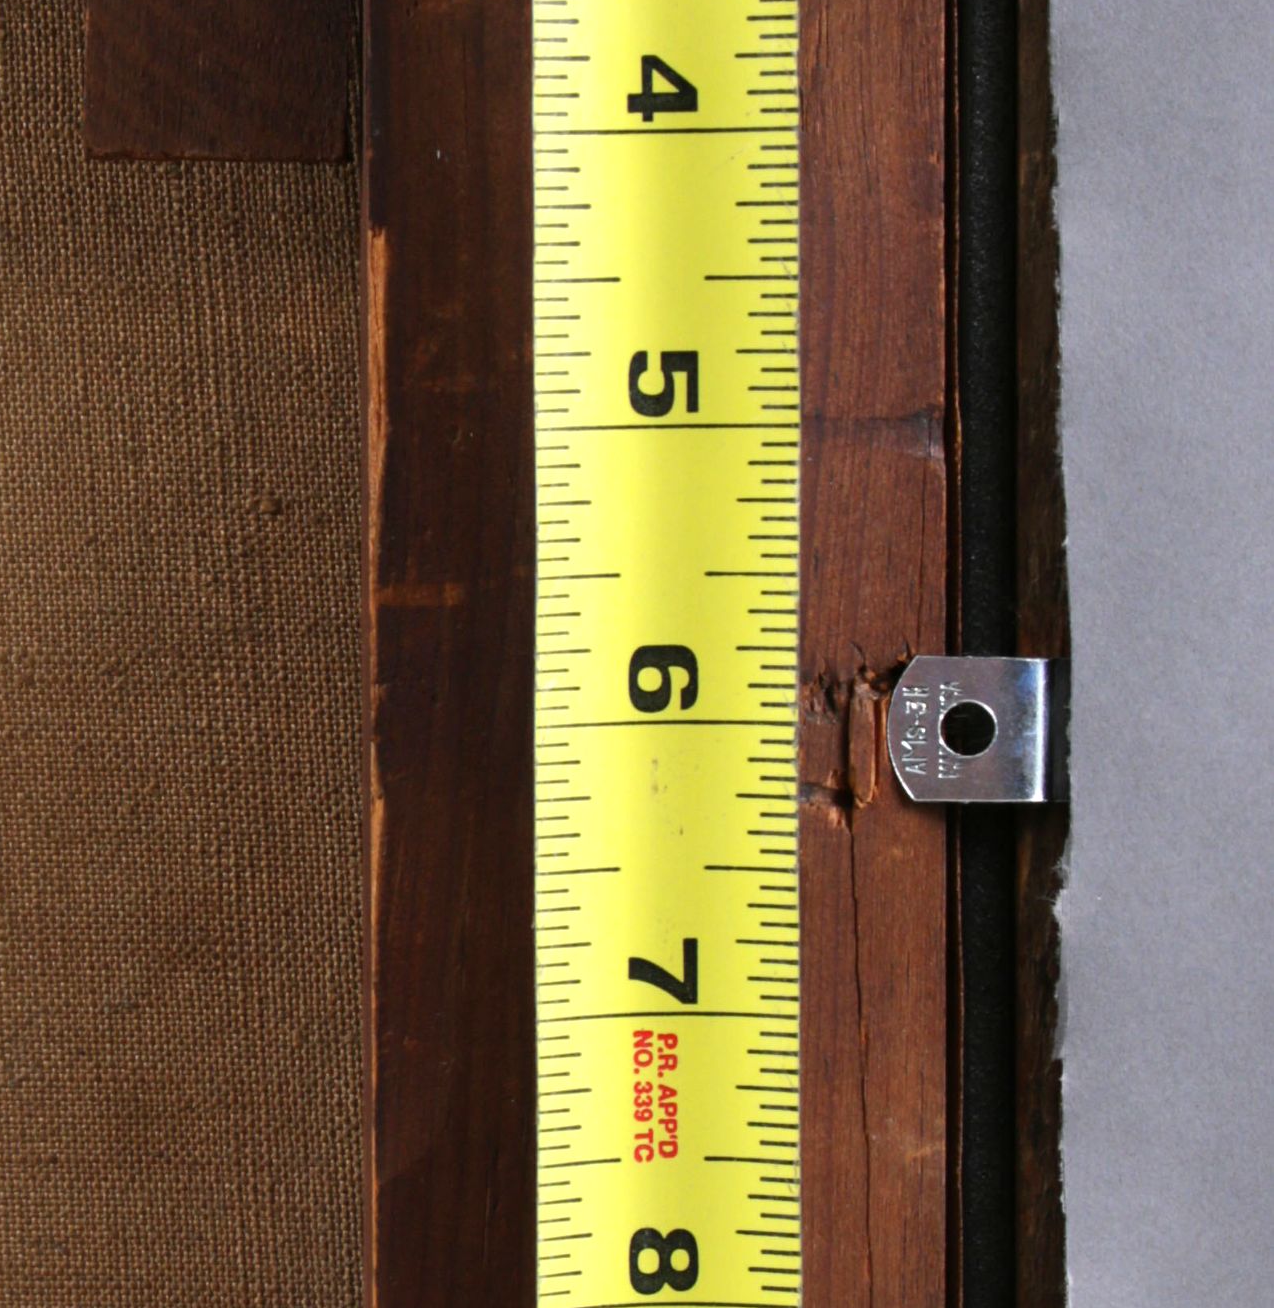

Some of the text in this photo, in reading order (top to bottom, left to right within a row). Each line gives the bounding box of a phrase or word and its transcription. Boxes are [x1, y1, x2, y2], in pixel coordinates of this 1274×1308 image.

[627, 54, 699, 123] 4
[629, 350, 699, 418] 5
[629, 644, 699, 714] 6
[629, 937, 699, 1005] 7
[656, 1033, 679, 1078] P.R.
[632, 1029, 655, 1163] NO. 339 TC
[629, 1227, 700, 1296] 8
